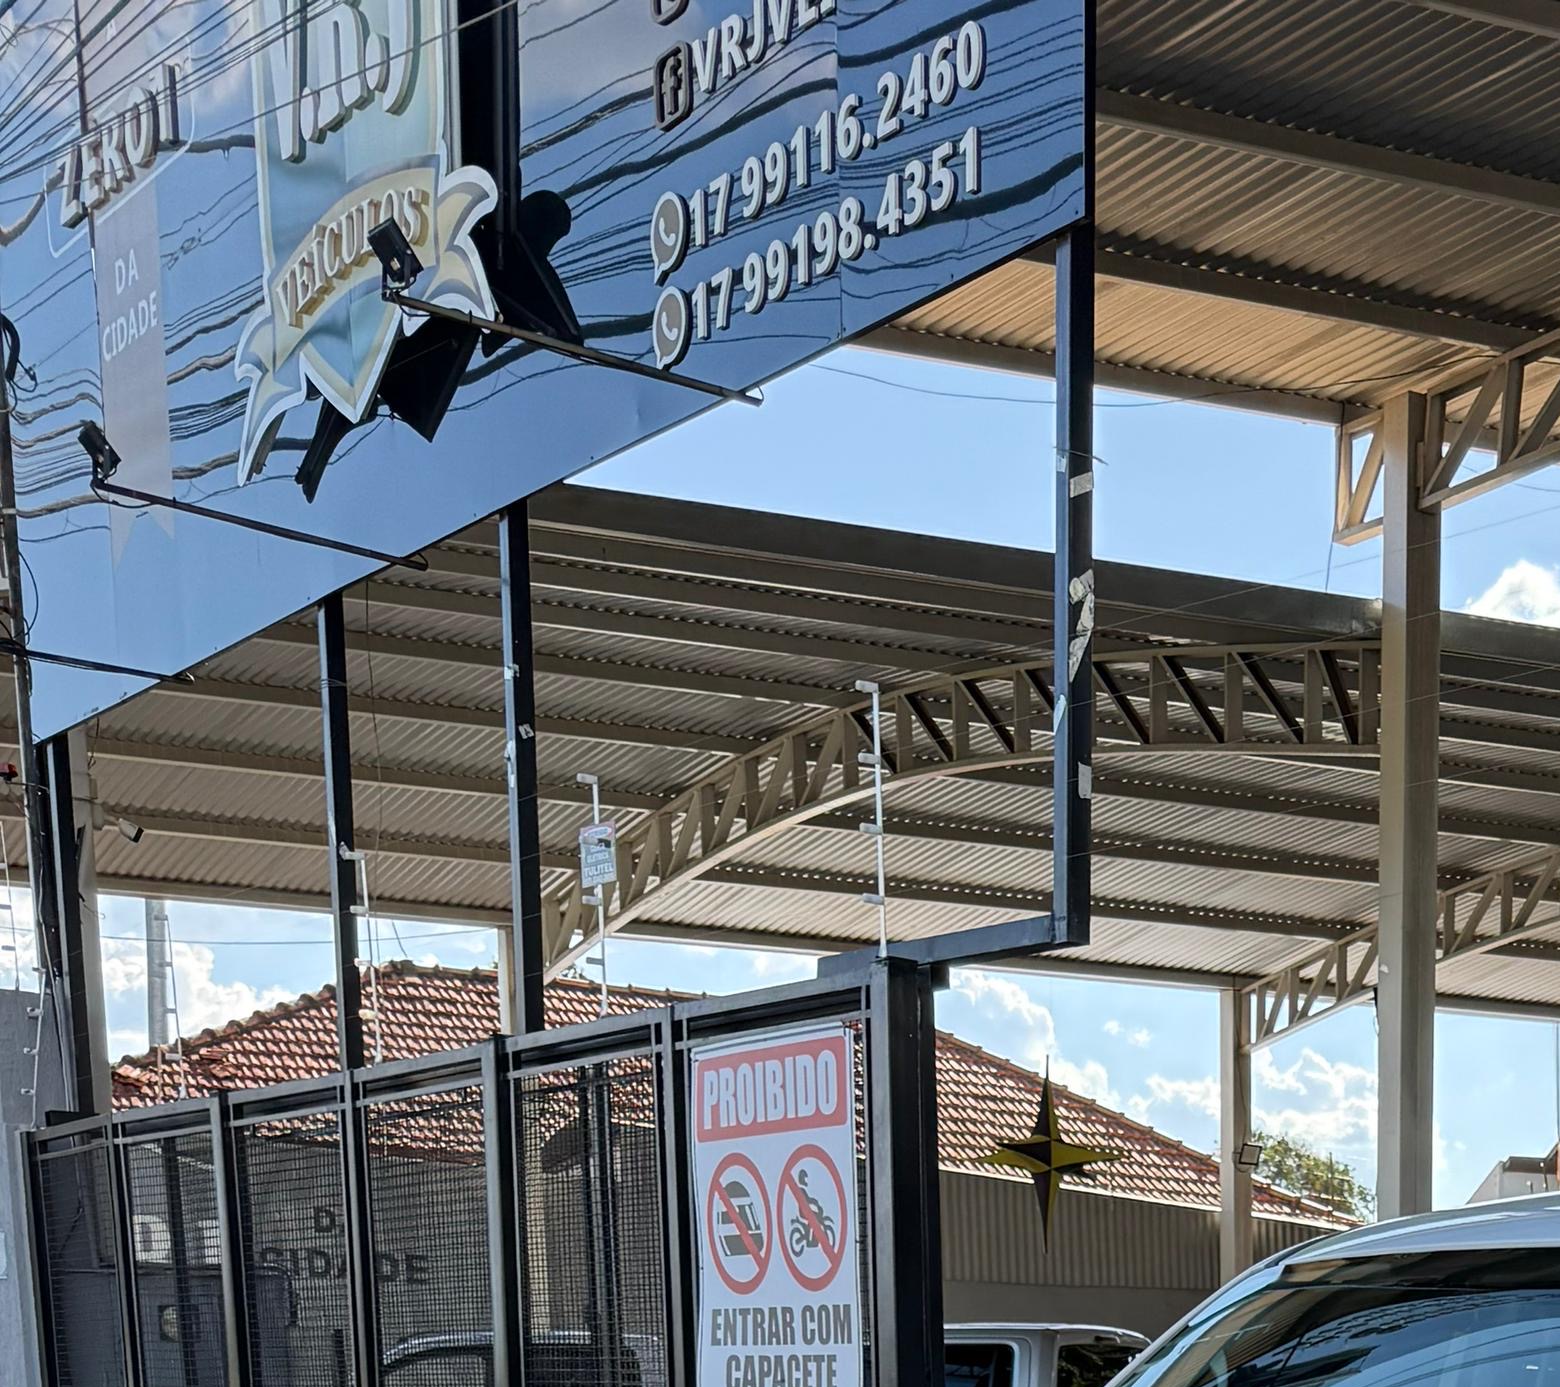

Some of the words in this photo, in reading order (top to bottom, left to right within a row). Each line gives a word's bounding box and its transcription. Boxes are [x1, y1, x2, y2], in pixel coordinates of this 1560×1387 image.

[689, 172, 733, 248] 17
[741, 20, 987, 220] 99116.2460
[691, 265, 733, 340] 17
[743, 125, 983, 314] 99198.4351
[115, 248, 138, 295] DA
[103, 290, 158, 361] CIDADE
[703, 1050, 838, 1130] PROIBIDO
[710, 1306, 796, 1346] ENTRAR
[801, 1304, 853, 1345] COM
